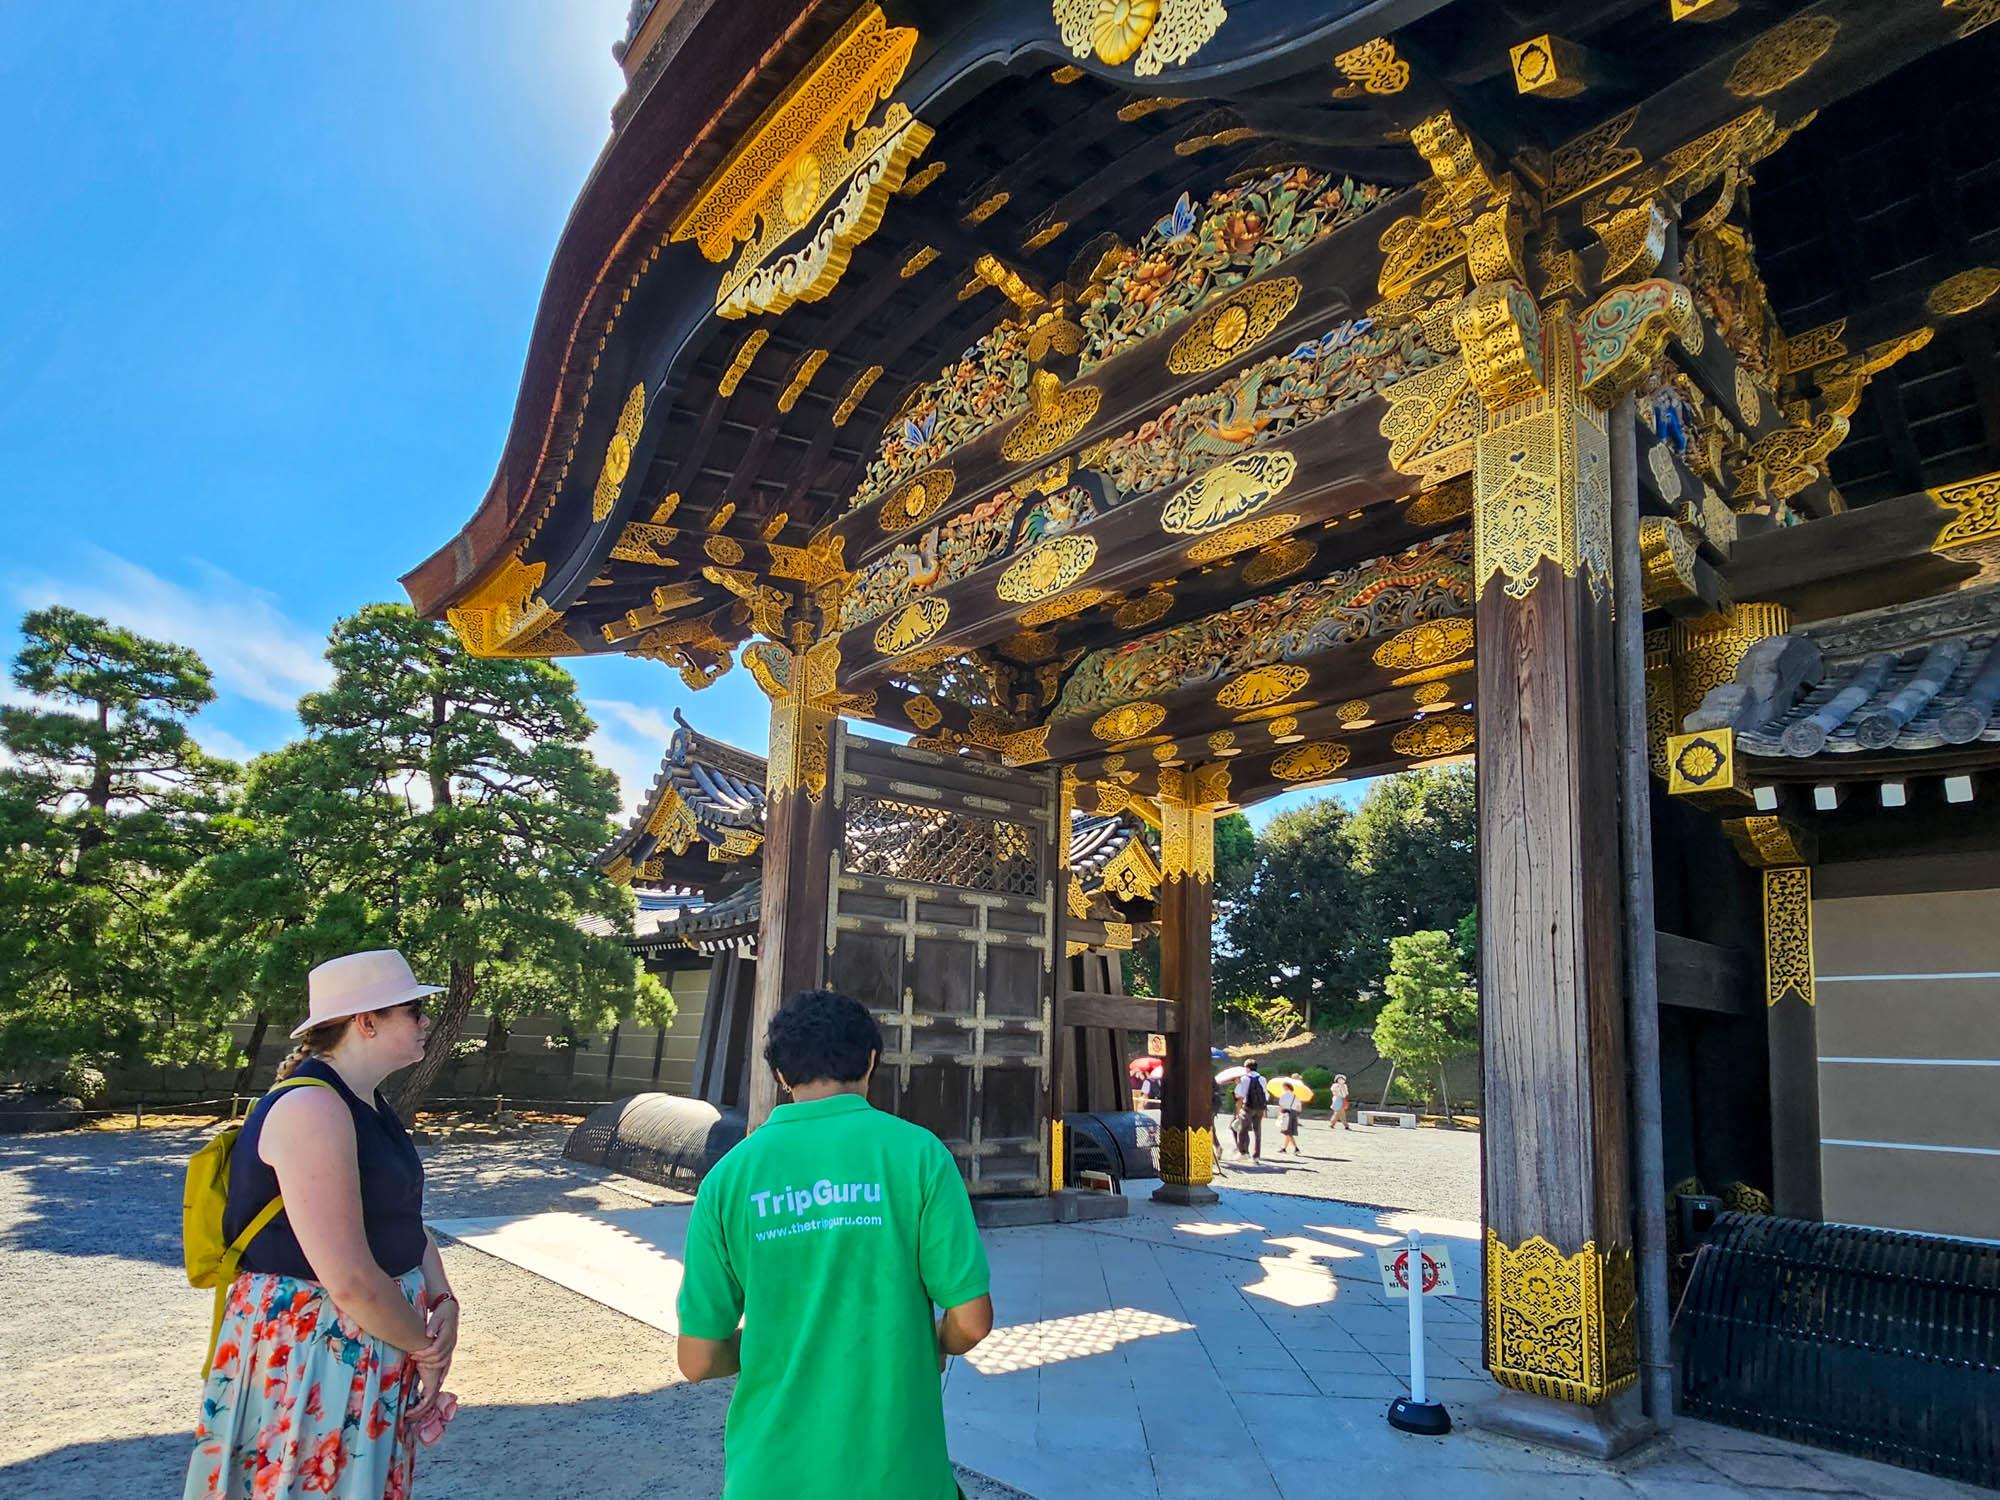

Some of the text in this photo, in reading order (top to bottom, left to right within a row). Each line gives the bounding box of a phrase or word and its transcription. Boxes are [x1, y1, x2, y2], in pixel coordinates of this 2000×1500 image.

[751, 1179, 881, 1217] TripGuru
[755, 1215, 882, 1242] www.thetripguru.com
[1384, 1264, 1396, 1272] DO
[1421, 1262, 1447, 1270] OUCH
